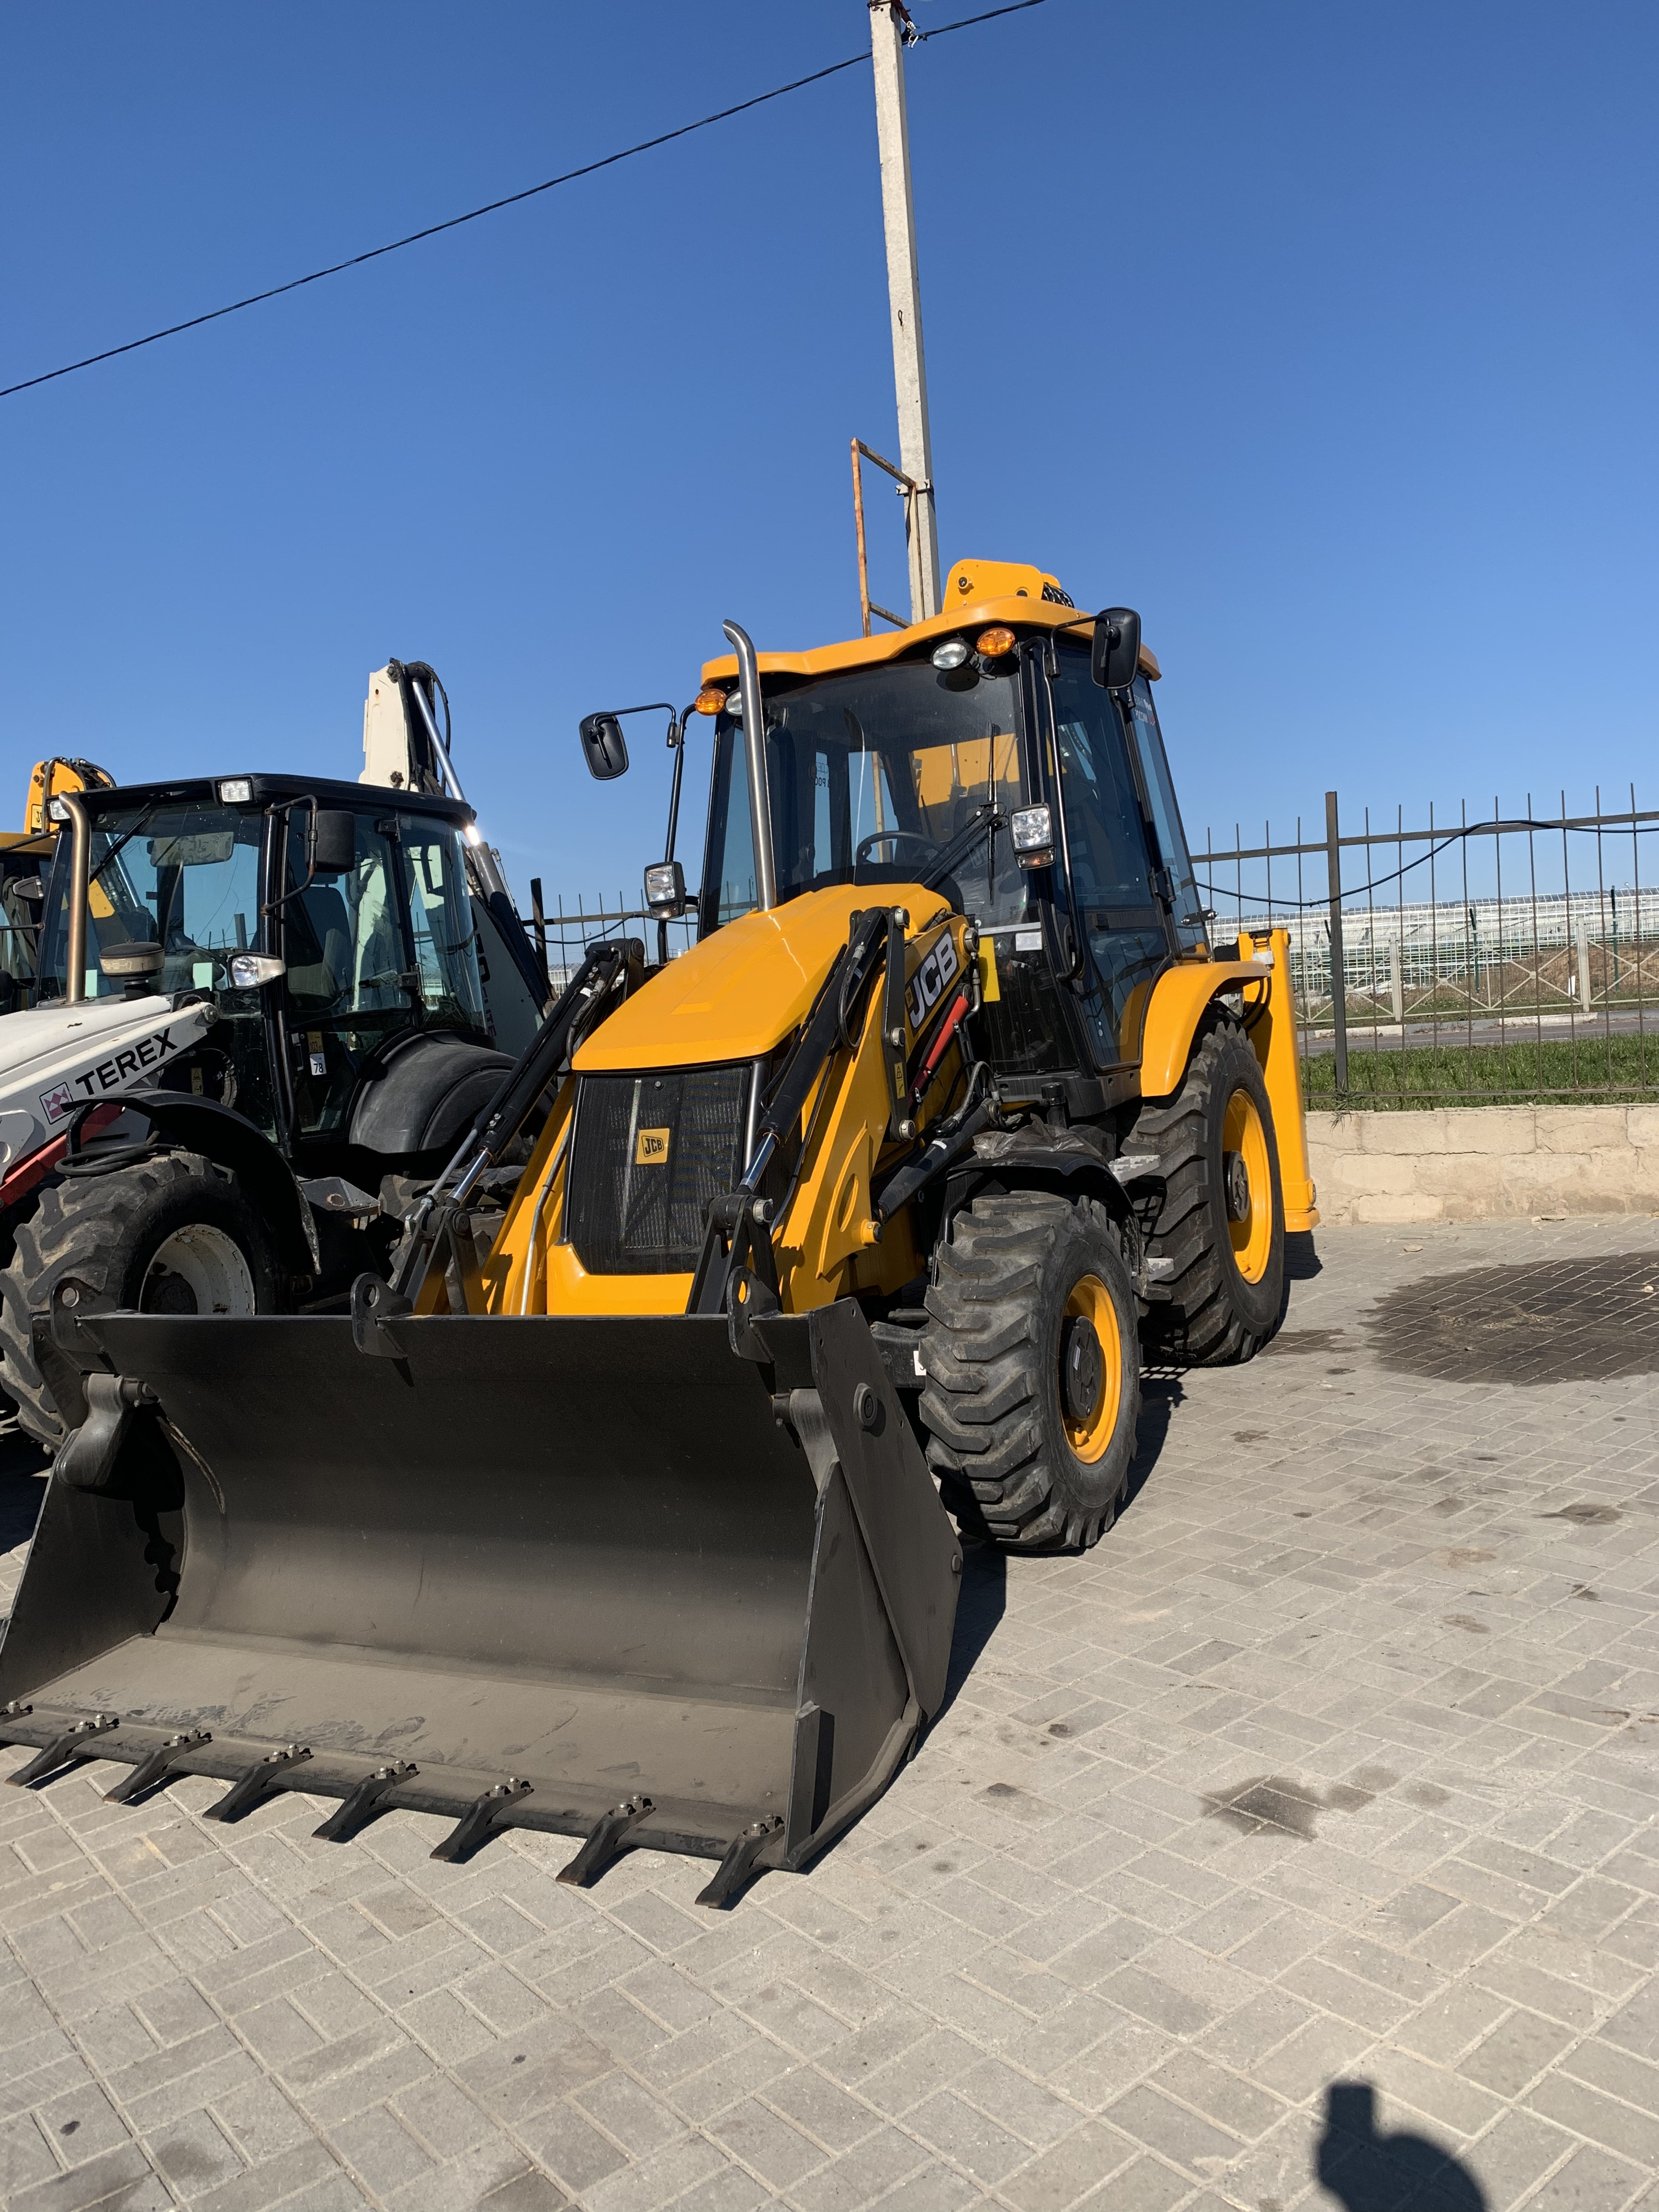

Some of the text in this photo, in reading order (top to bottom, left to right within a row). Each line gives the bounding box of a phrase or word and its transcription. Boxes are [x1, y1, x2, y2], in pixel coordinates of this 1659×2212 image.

[910, 933, 957, 1028] JCB
[75, 1026, 178, 1096] TEREX
[313, 1063, 324, 1074] 78
[645, 1138, 663, 1155] JCB
